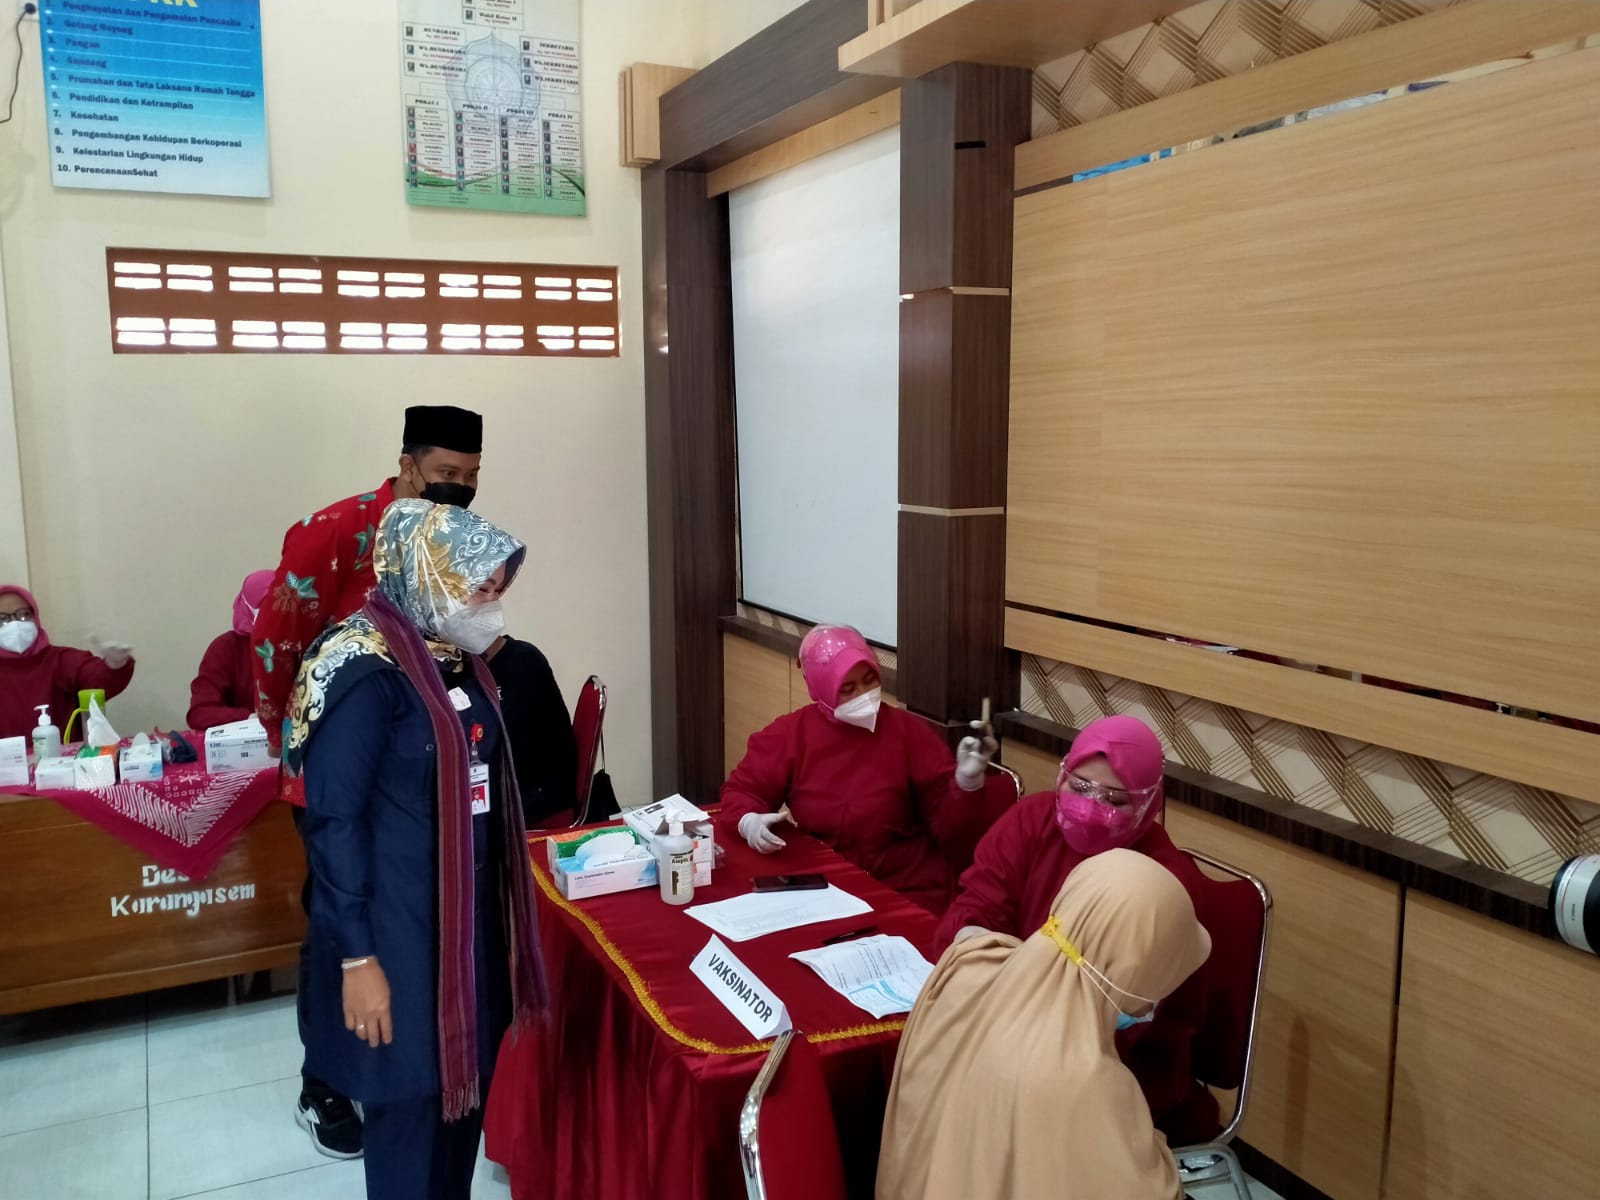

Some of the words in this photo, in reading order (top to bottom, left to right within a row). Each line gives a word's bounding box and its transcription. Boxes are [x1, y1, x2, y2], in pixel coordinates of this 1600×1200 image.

[117, 79, 134, 88] dan
[135, 80, 154, 89] Tata
[155, 82, 193, 92] Laksana
[194, 85, 224, 95] Rumah
[225, 87, 256, 98] Tangga
[69, 93, 120, 105] Pendidikan
[121, 97, 139, 106] dan
[53, 109, 62, 118] 7.
[70, 111, 119, 122] Kesehatan
[71, 128, 140, 142] Pengembangan
[142, 133, 189, 145] Kehidupan
[190, 136, 242, 148] Berkoperasi
[55, 145, 64, 154] 9.
[72, 147, 124, 158] Kelestarian
[126, 150, 177, 162] Lingkungan
[178, 153, 204, 164] Hidup
[57, 164, 71, 172] 10.
[110, 883, 256, 917] Karangasem
[708, 953, 773, 1023] VAKSINATOR
